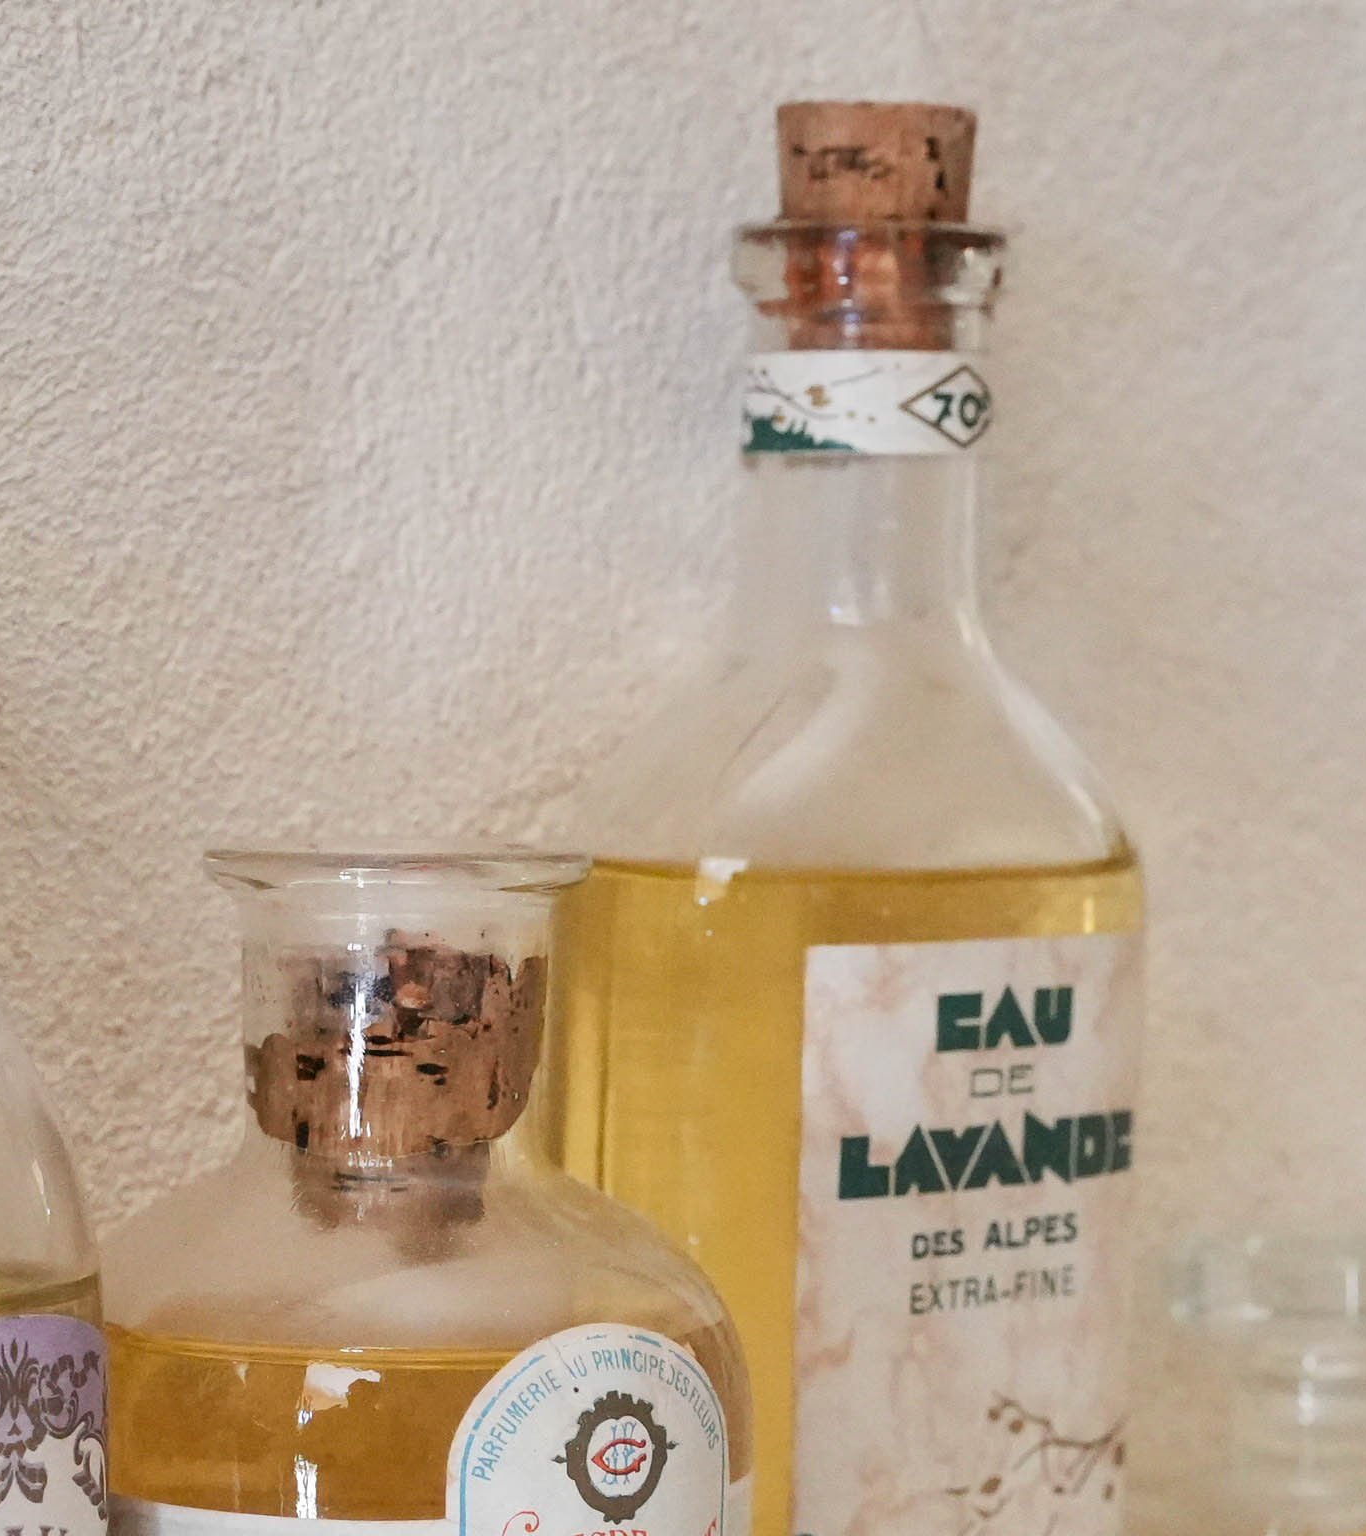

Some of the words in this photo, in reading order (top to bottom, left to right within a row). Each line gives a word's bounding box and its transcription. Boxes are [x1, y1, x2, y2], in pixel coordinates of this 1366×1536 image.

[936, 983, 1074, 1052] EAU
[970, 1064, 1033, 1098] DE
[839, 1109, 1133, 1200] LAVANDE
[911, 1229, 964, 1259] DES
[984, 1213, 1078, 1249] ALPES
[910, 1264, 1076, 1315] EXTRA-FINE
[472, 1368, 562, 1482] PARFUMERIE
[591, 1349, 667, 1381] PRINCIPE
[688, 1388, 720, 1450] FLEURS
